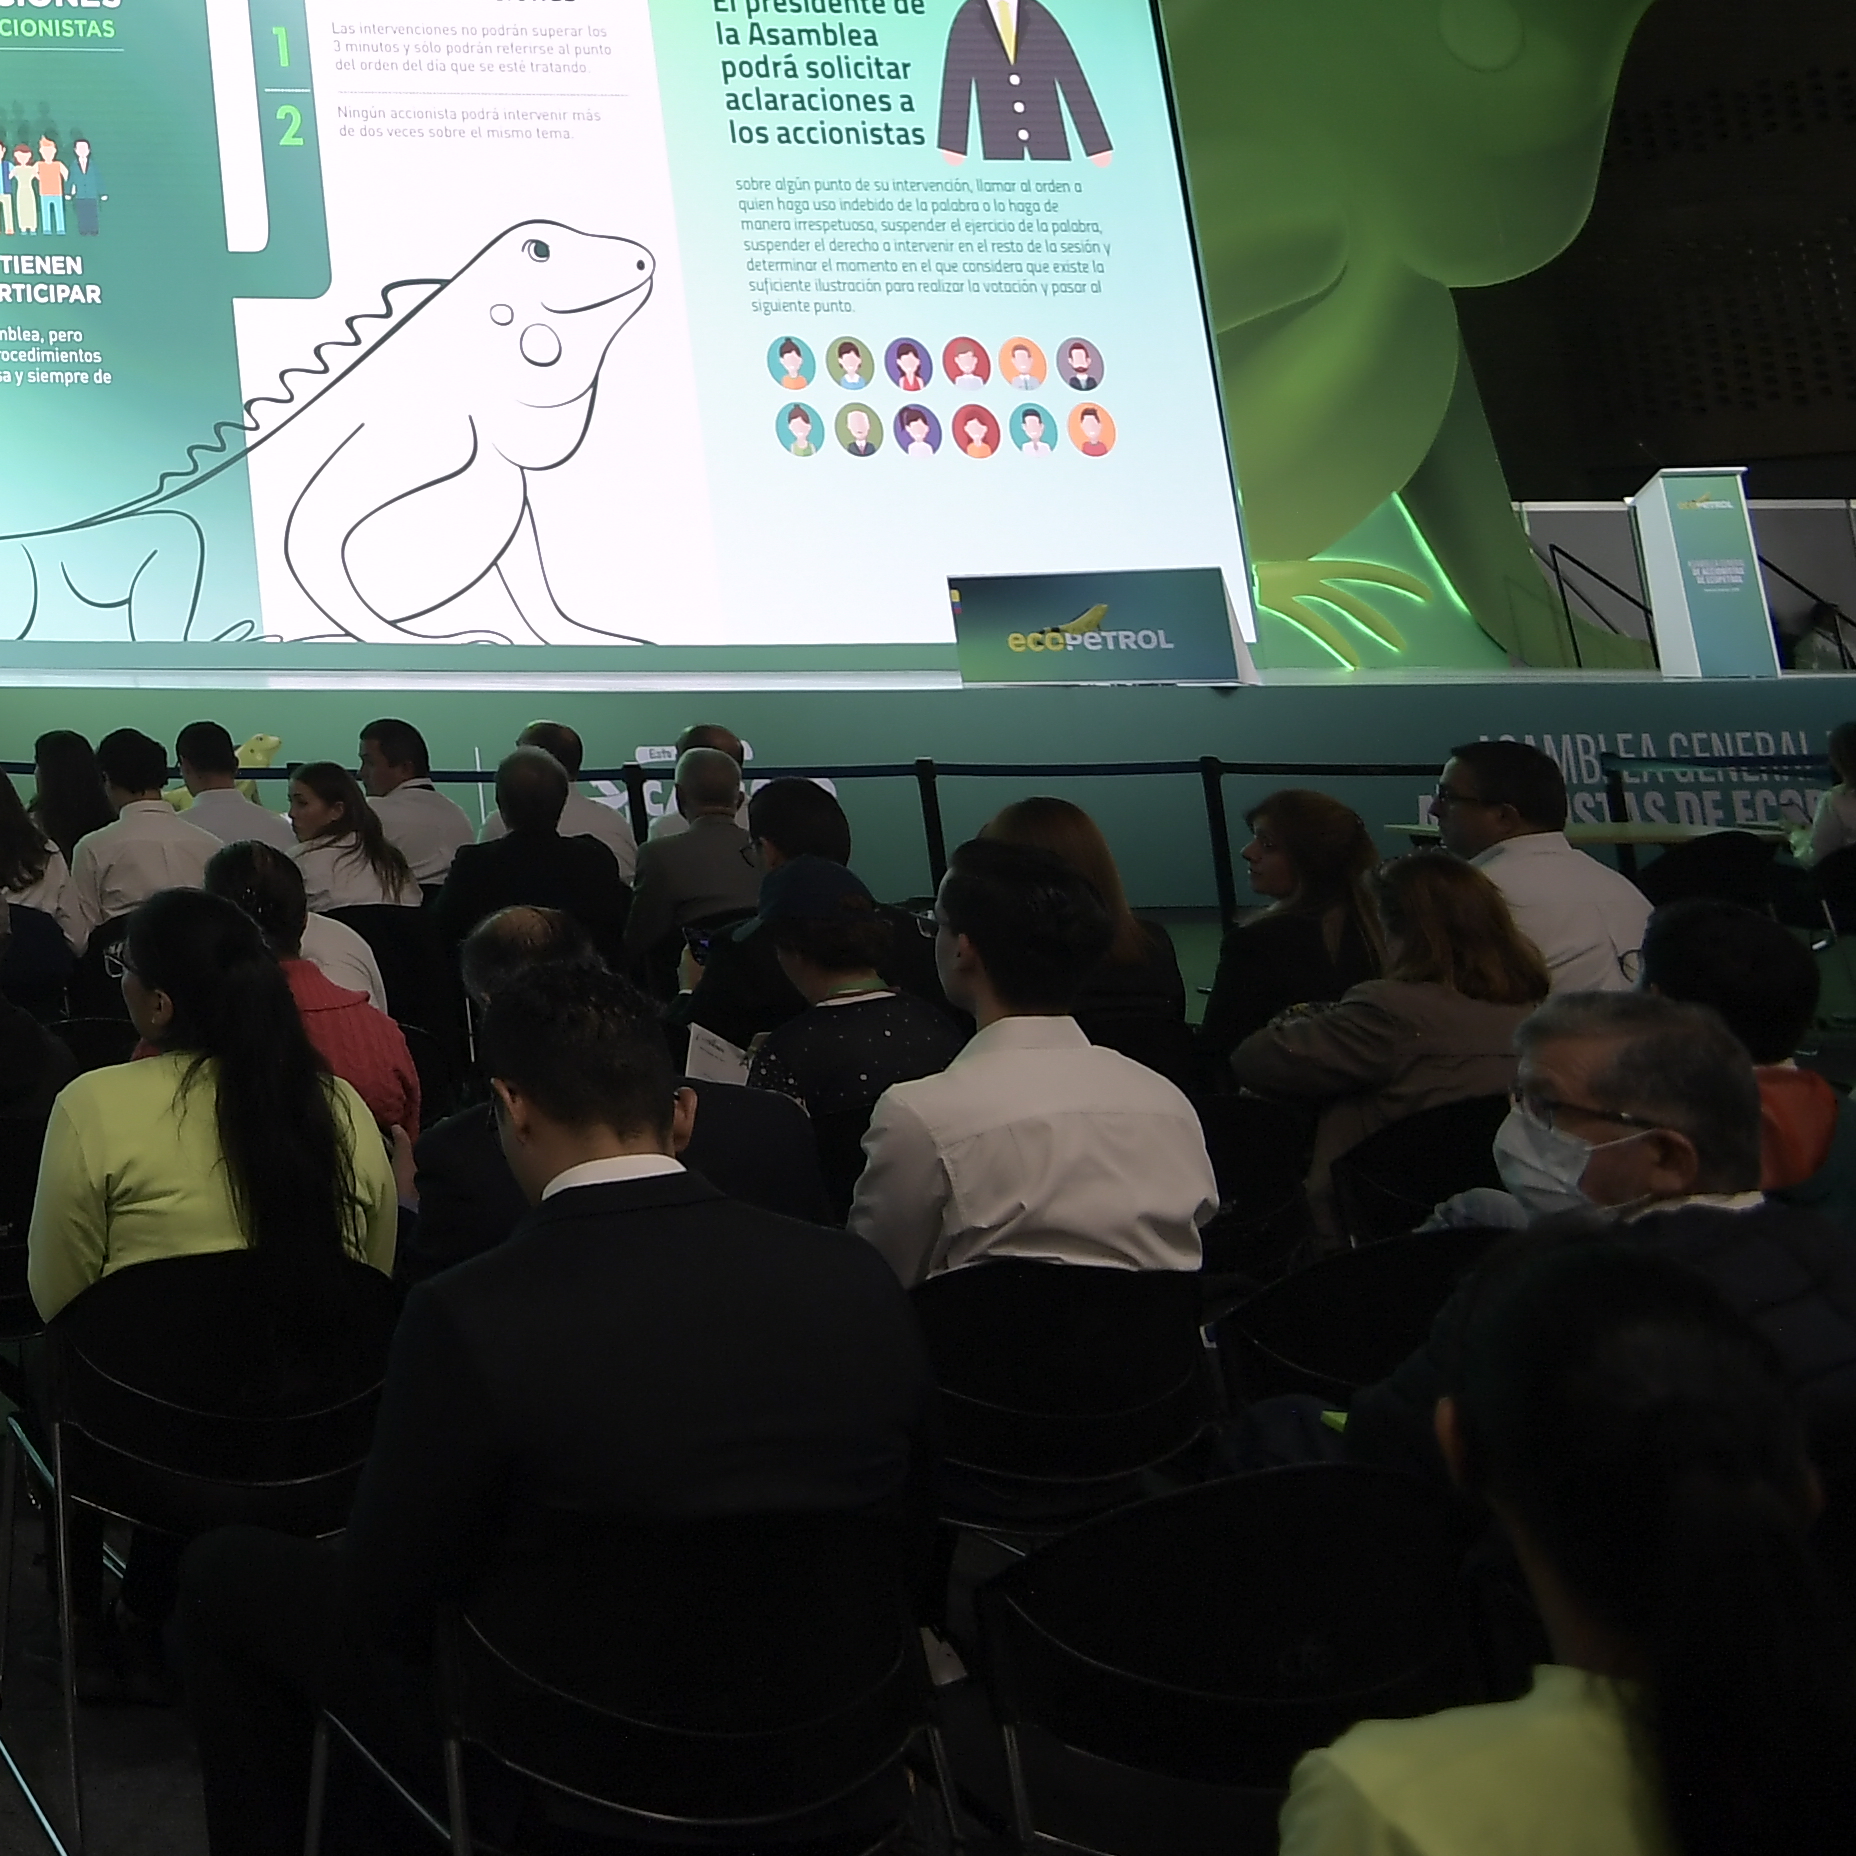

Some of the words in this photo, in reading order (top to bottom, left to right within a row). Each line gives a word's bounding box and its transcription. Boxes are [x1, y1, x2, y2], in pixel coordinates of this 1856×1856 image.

[716, 21, 740, 45] la
[749, 22, 878, 46] Asamblea
[271, 27, 289, 67] 1
[721, 53, 799, 85] podrá
[806, 55, 911, 79] solicitar
[725, 86, 892, 112] aclaraciones
[900, 94, 915, 112] a
[276, 105, 304, 146] 2
[729, 119, 769, 144] los
[777, 120, 925, 145] accionistas
[0, 255, 82, 275] TIENEN
[49, 331, 82, 345] pero
[15, 371, 23, 386] y
[28, 367, 89, 387] siempre
[94, 368, 112, 384] de
